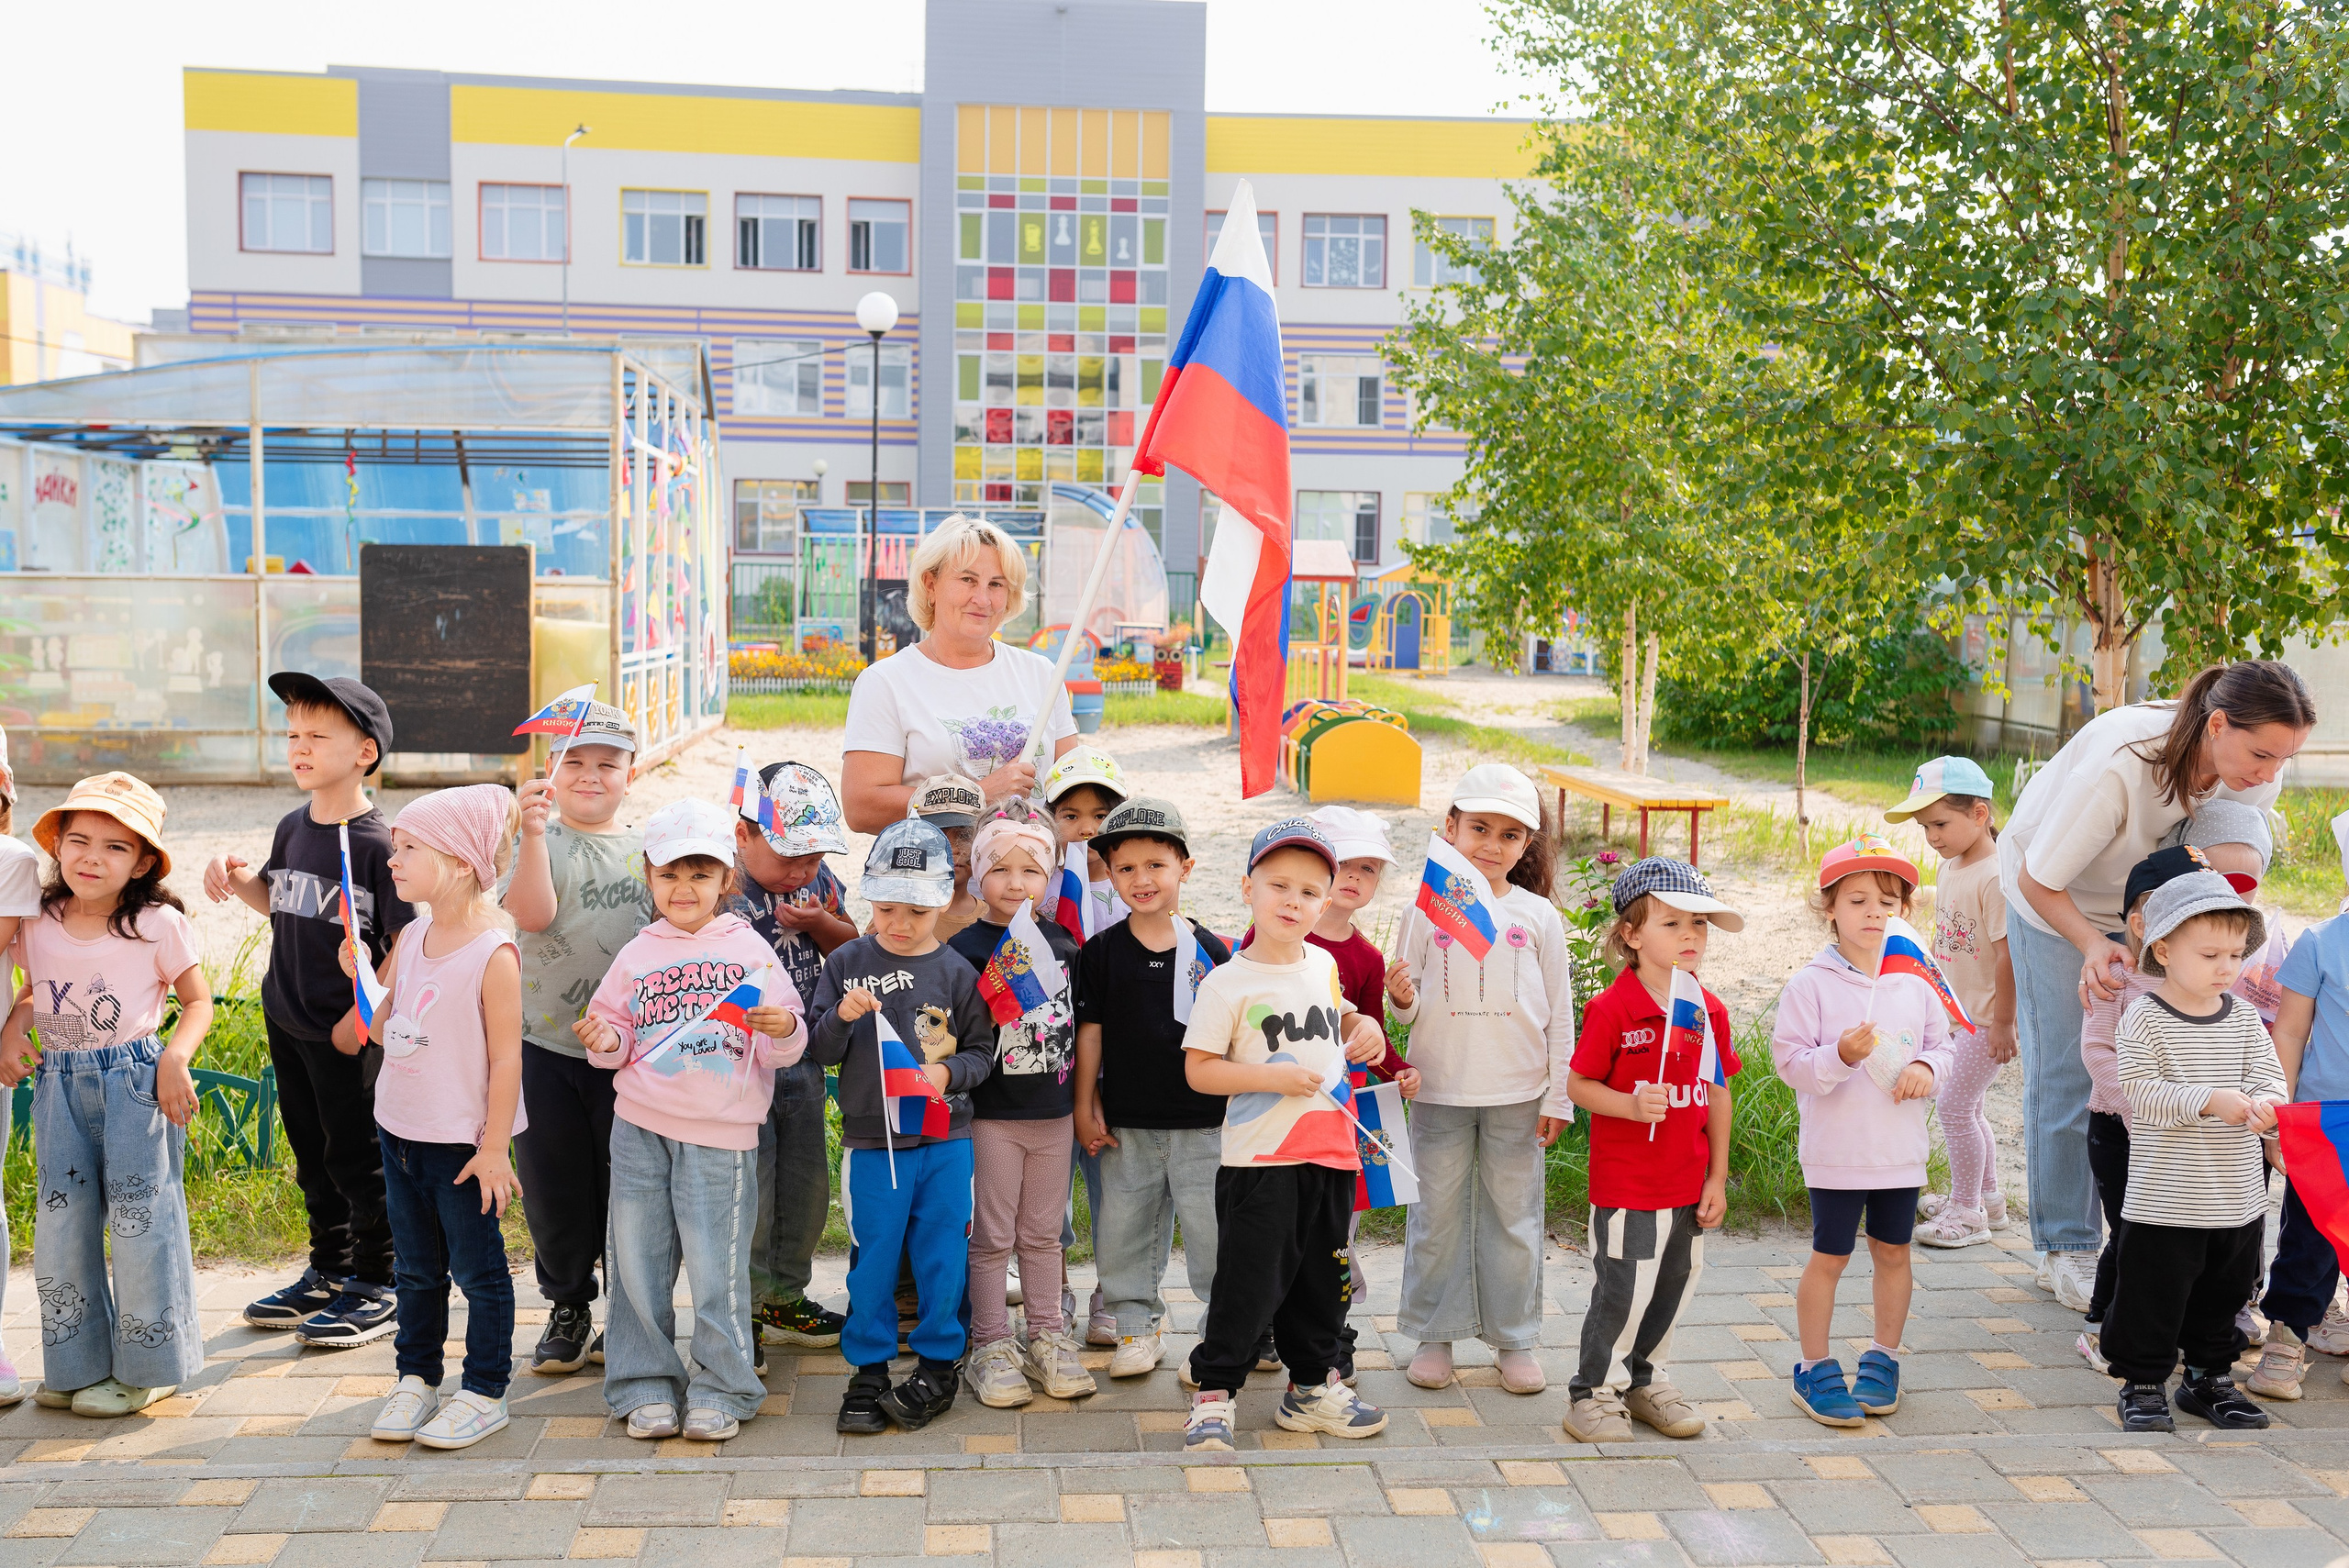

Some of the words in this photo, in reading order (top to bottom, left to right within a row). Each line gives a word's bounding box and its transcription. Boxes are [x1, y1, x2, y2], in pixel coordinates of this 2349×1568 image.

[593, 703, 620, 719] YORK
[924, 787, 981, 809] EXPLORE
[1107, 807, 1165, 833] EXPLORE
[896, 857, 921, 868] COOL
[897, 848, 923, 859] JUST
[1430, 895, 1468, 929] РОССИЯ
[544, 943, 562, 960] EACH
[547, 929, 576, 957] MOMENT
[633, 962, 745, 1003] DREAMS
[633, 995, 680, 1030] OME
[1261, 1005, 1340, 1052] PLAY
[678, 1041, 693, 1052] You
[696, 1038, 707, 1047] are
[693, 1041, 717, 1056] Loved
[1627, 1047, 1649, 1055] Audi
